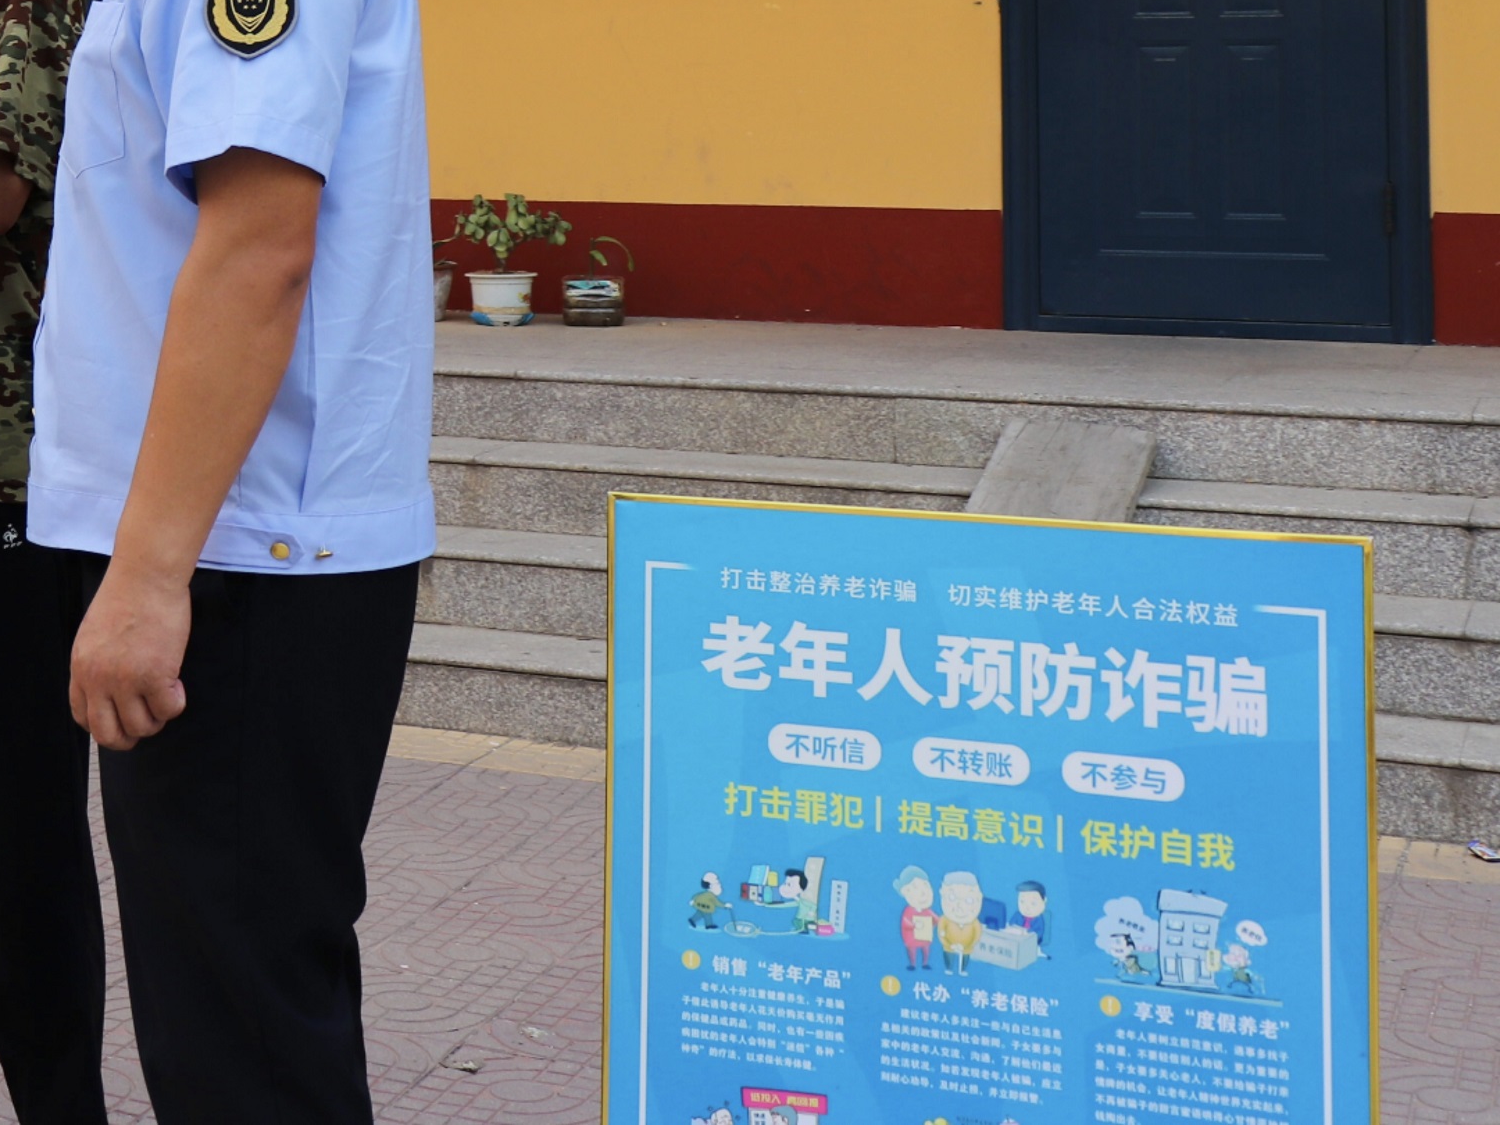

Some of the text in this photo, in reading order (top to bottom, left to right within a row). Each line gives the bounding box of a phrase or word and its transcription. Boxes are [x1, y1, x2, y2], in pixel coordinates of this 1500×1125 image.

[720, 567, 1239, 628] 打击整治养老诈骗 切实维护老年人合法权益
[701, 616, 1268, 738] 老年人预防诈骗
[784, 731, 1167, 795] 不听信 不转账 不参与
[724, 782, 1236, 871] 打击罪犯 提高意识 保护自我
[712, 955, 850, 989] 销售“老年产品”
[913, 982, 1059, 1017] 代办“养老保险”
[1134, 1002, 1290, 1040] 享受“度假养老”
